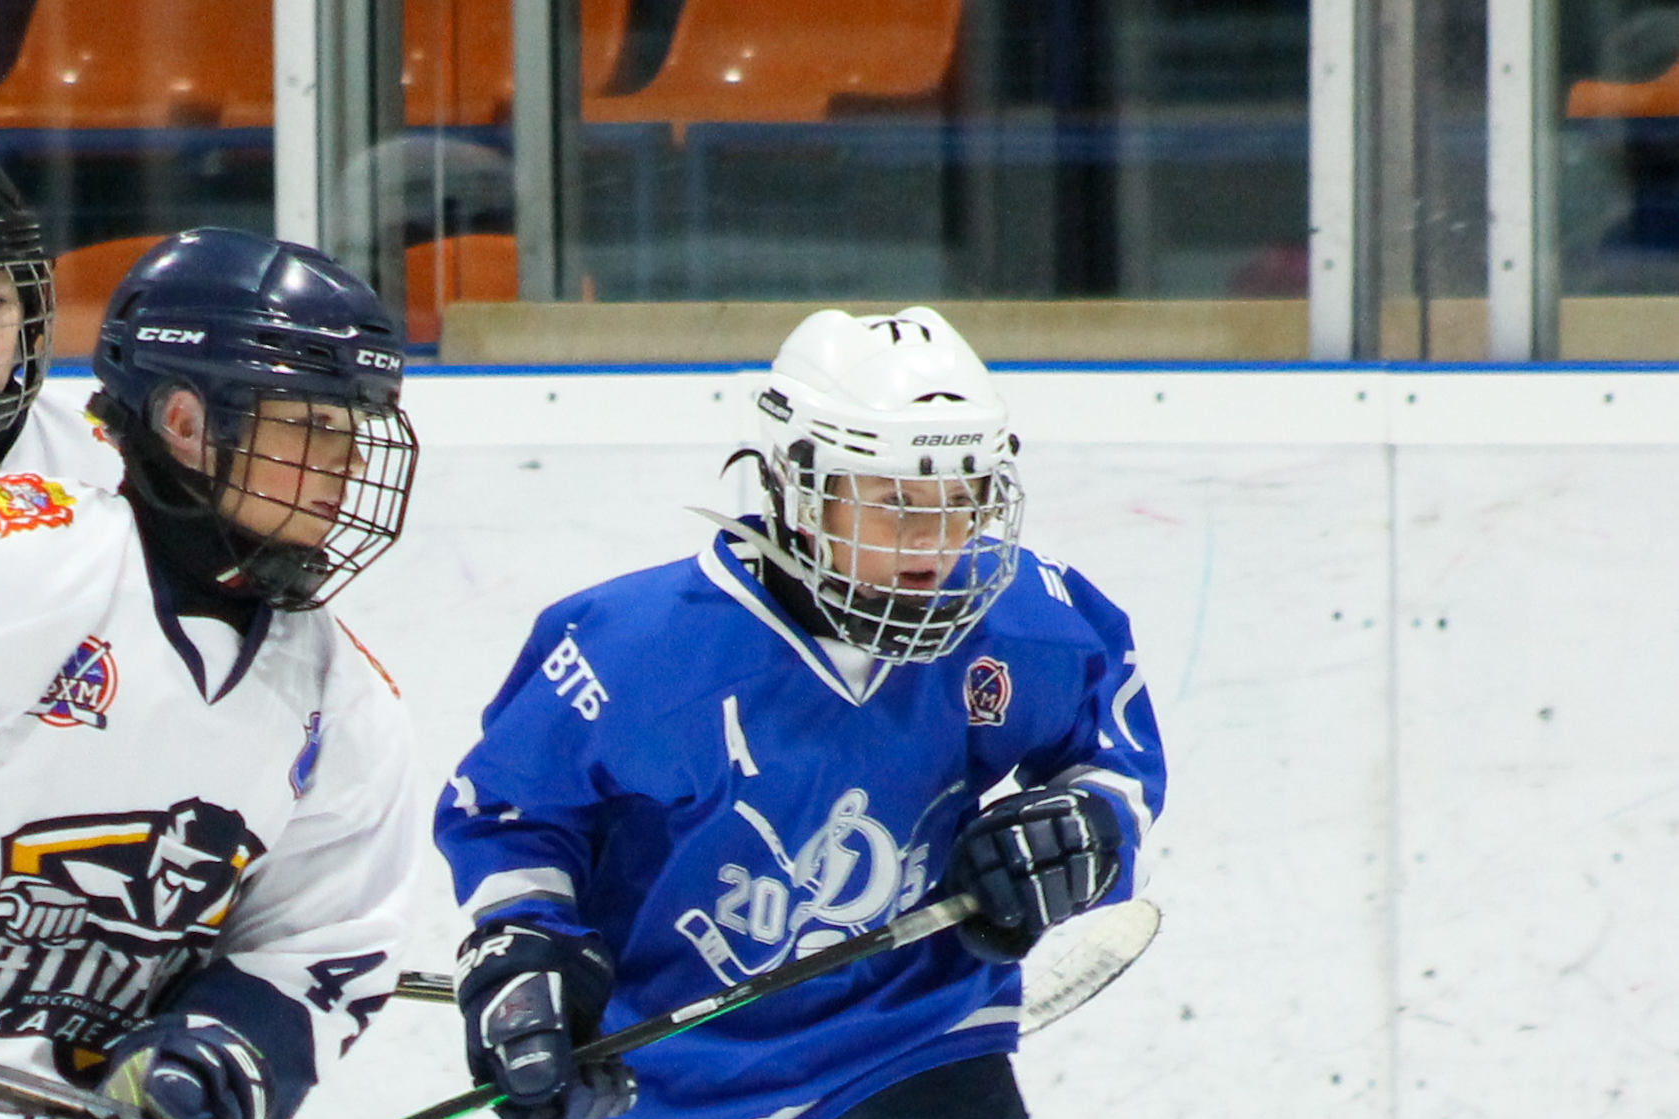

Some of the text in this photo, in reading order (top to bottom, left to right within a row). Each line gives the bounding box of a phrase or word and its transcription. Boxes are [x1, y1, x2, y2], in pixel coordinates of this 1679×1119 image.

[135, 326, 206, 345] CCM
[356, 348, 401, 371] CCM
[542, 636, 610, 722] ВТБ
